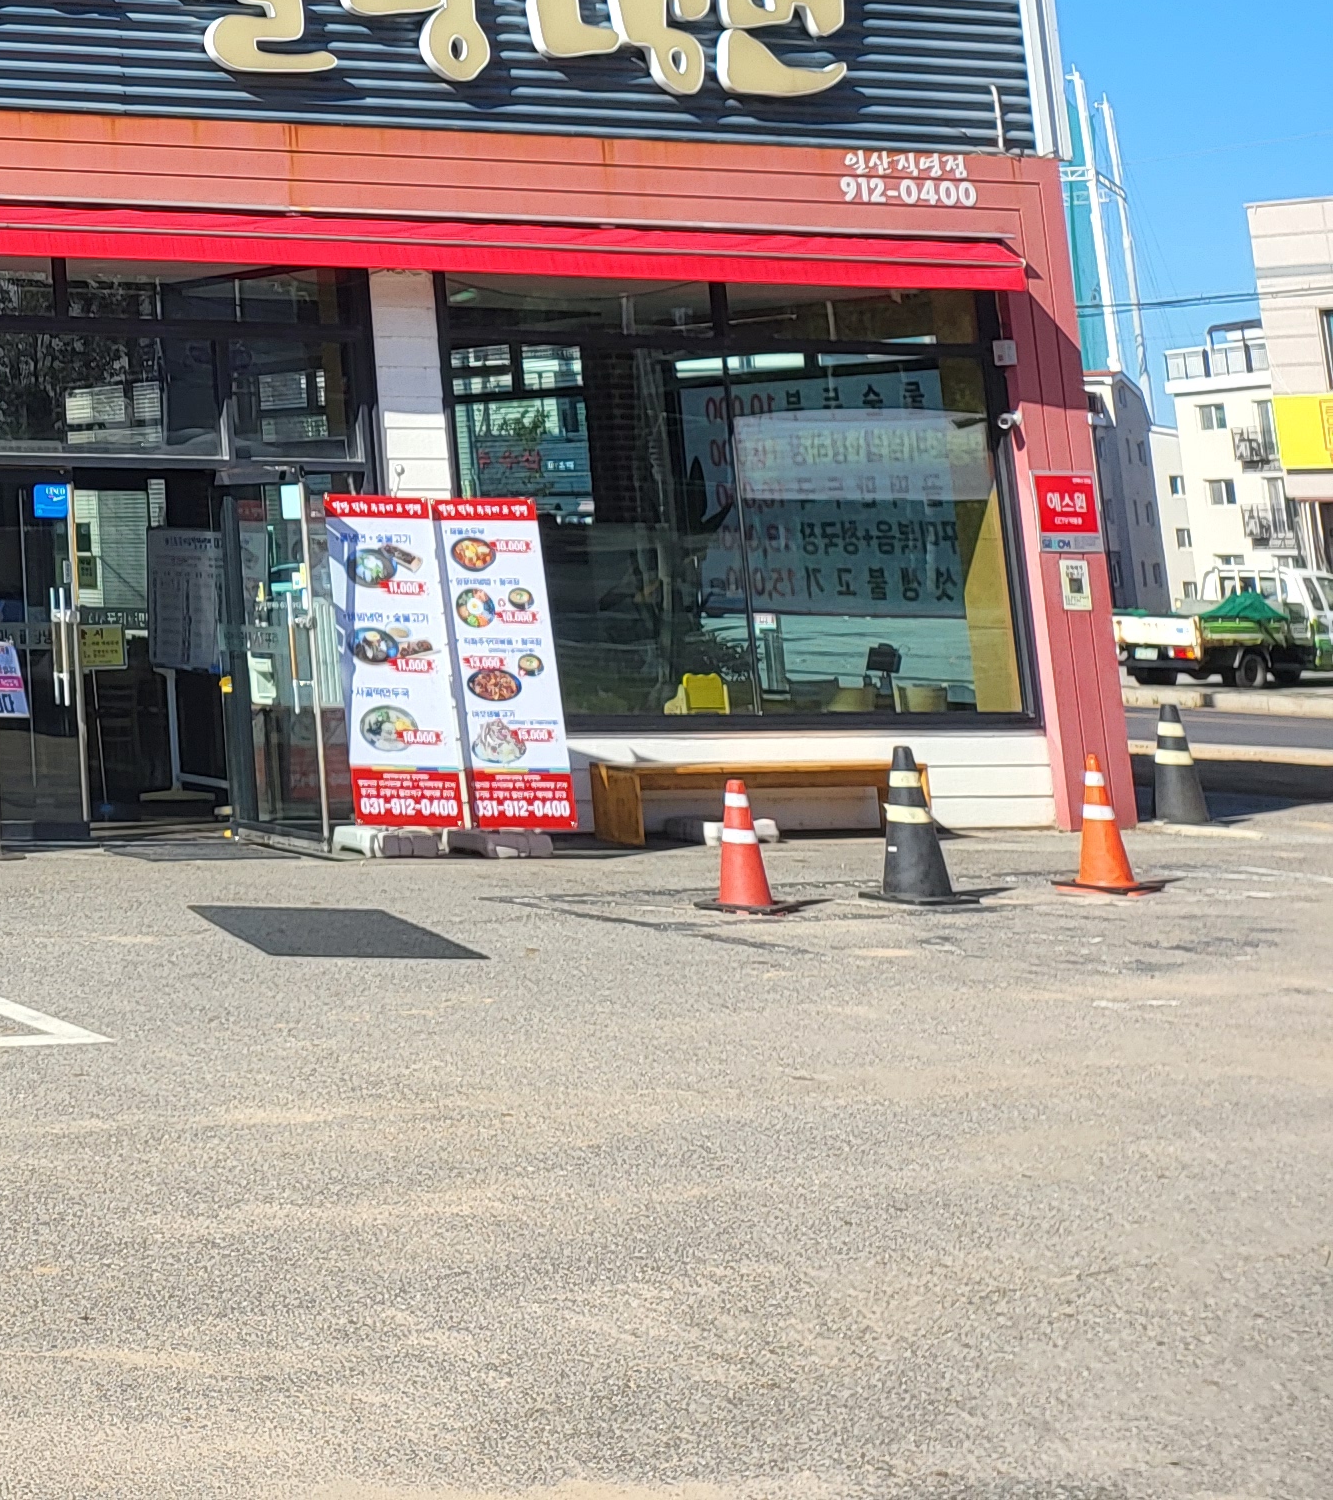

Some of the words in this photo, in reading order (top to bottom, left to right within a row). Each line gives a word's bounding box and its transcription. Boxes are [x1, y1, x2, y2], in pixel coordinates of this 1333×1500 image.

[844, 150, 968, 179] 일산직영점
[840, 176, 977, 207] 912-0400
[1046, 491, 1087, 512] 에스원
[360, 798, 459, 817] 031-912-0400
[474, 799, 571, 818] 031-912-0400
